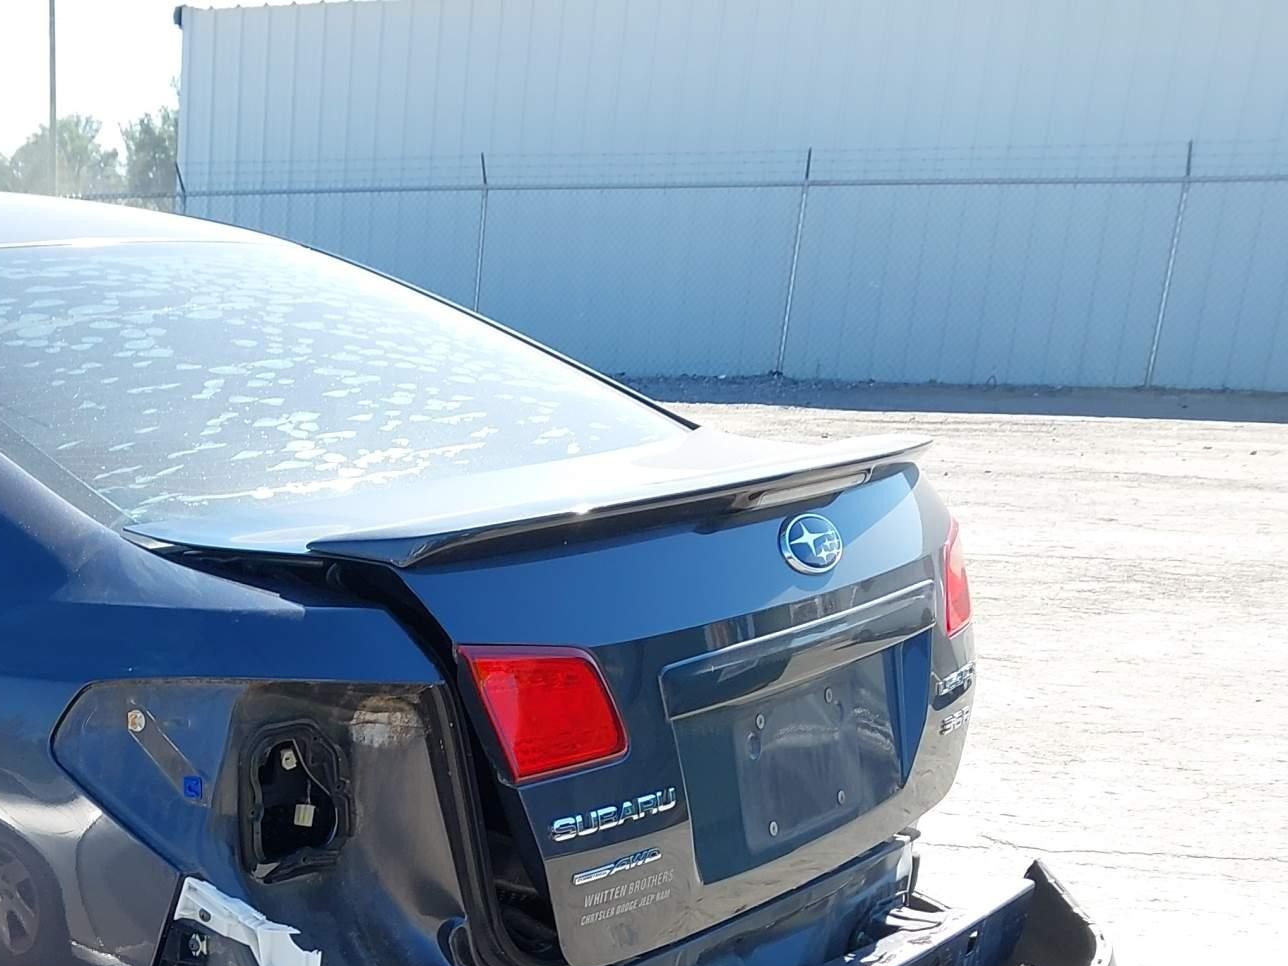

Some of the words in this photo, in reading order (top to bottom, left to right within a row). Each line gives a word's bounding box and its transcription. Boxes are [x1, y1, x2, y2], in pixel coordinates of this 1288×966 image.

[551, 787, 677, 842] SUBARU
[610, 847, 663, 876] AWD
[584, 885, 627, 908] WHITTEN
[628, 868, 675, 896] BROTHERS
[580, 906, 615, 926] CHRYSLER
[615, 898, 638, 915] DODGE
[638, 894, 656, 908] JEEP
